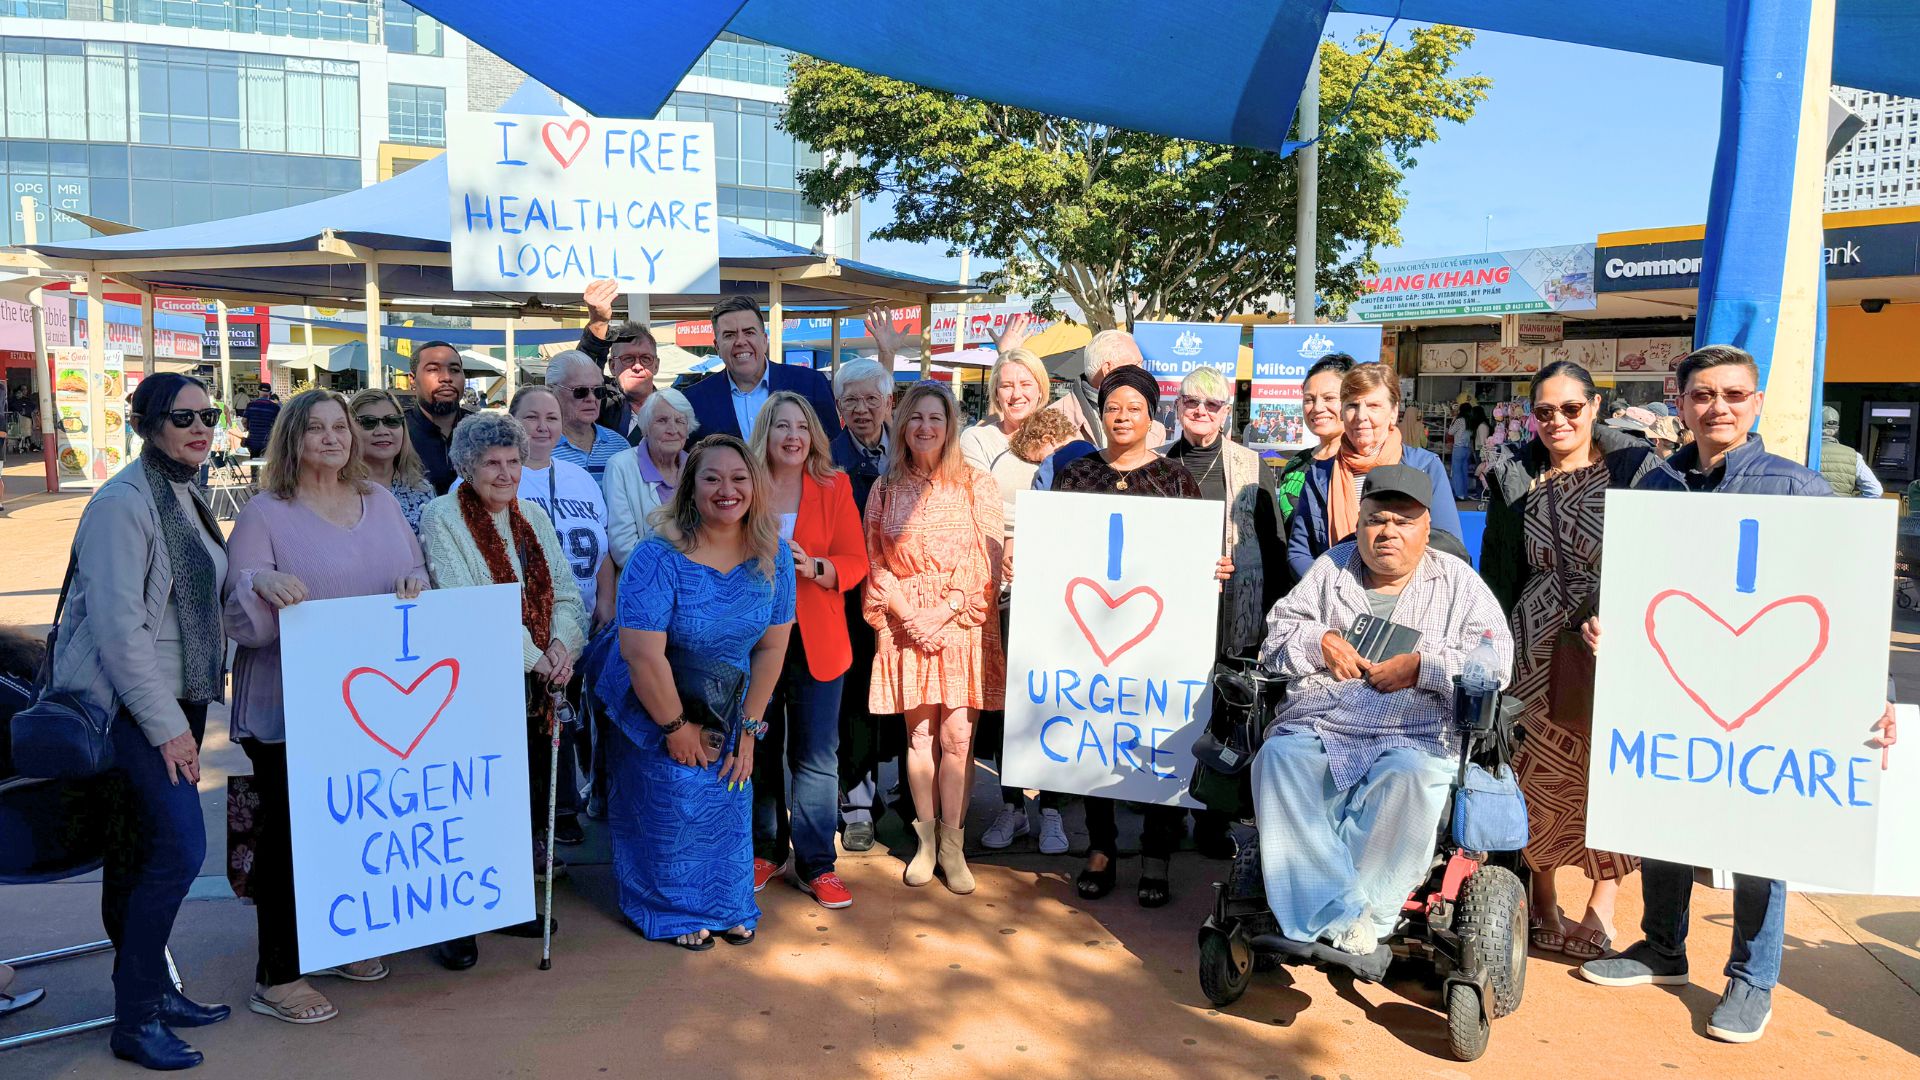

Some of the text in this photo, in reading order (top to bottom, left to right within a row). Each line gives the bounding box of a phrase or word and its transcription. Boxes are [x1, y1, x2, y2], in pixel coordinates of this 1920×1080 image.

[494, 121, 701, 174] I FREE
[15, 183, 43, 193] OPG
[58, 185, 80, 194] MRI
[62, 199, 79, 208] CT
[16, 212, 45, 222] BD
[498, 243, 664, 285] LOCALLY
[1823, 241, 1862, 266] ank
[1355, 266, 1511, 296] HANG KHANG
[1, 301, 17, 321] the
[20, 306, 34, 322] tea
[162, 301, 206, 311] Cincotta
[890, 308, 904, 320] 365
[205, 327, 255, 338] Amrican
[808, 317, 849, 328] CHEMST
[153, 329, 172, 347] EATS
[1214, 362, 1235, 374] MP
[1255, 362, 1306, 376] Milton
[1258, 388, 1290, 396] Federal
[1107, 513, 1124, 580] I
[1736, 518, 1759, 593] I
[394, 604, 420, 662] I
[1027, 669, 1208, 721] URGENT
[1040, 715, 1178, 779] CARE
[1609, 728, 1873, 807] MEDICARE
[326, 754, 502, 825] URGENT
[362, 817, 465, 875] CARE
[328, 865, 501, 936] CLINICS
